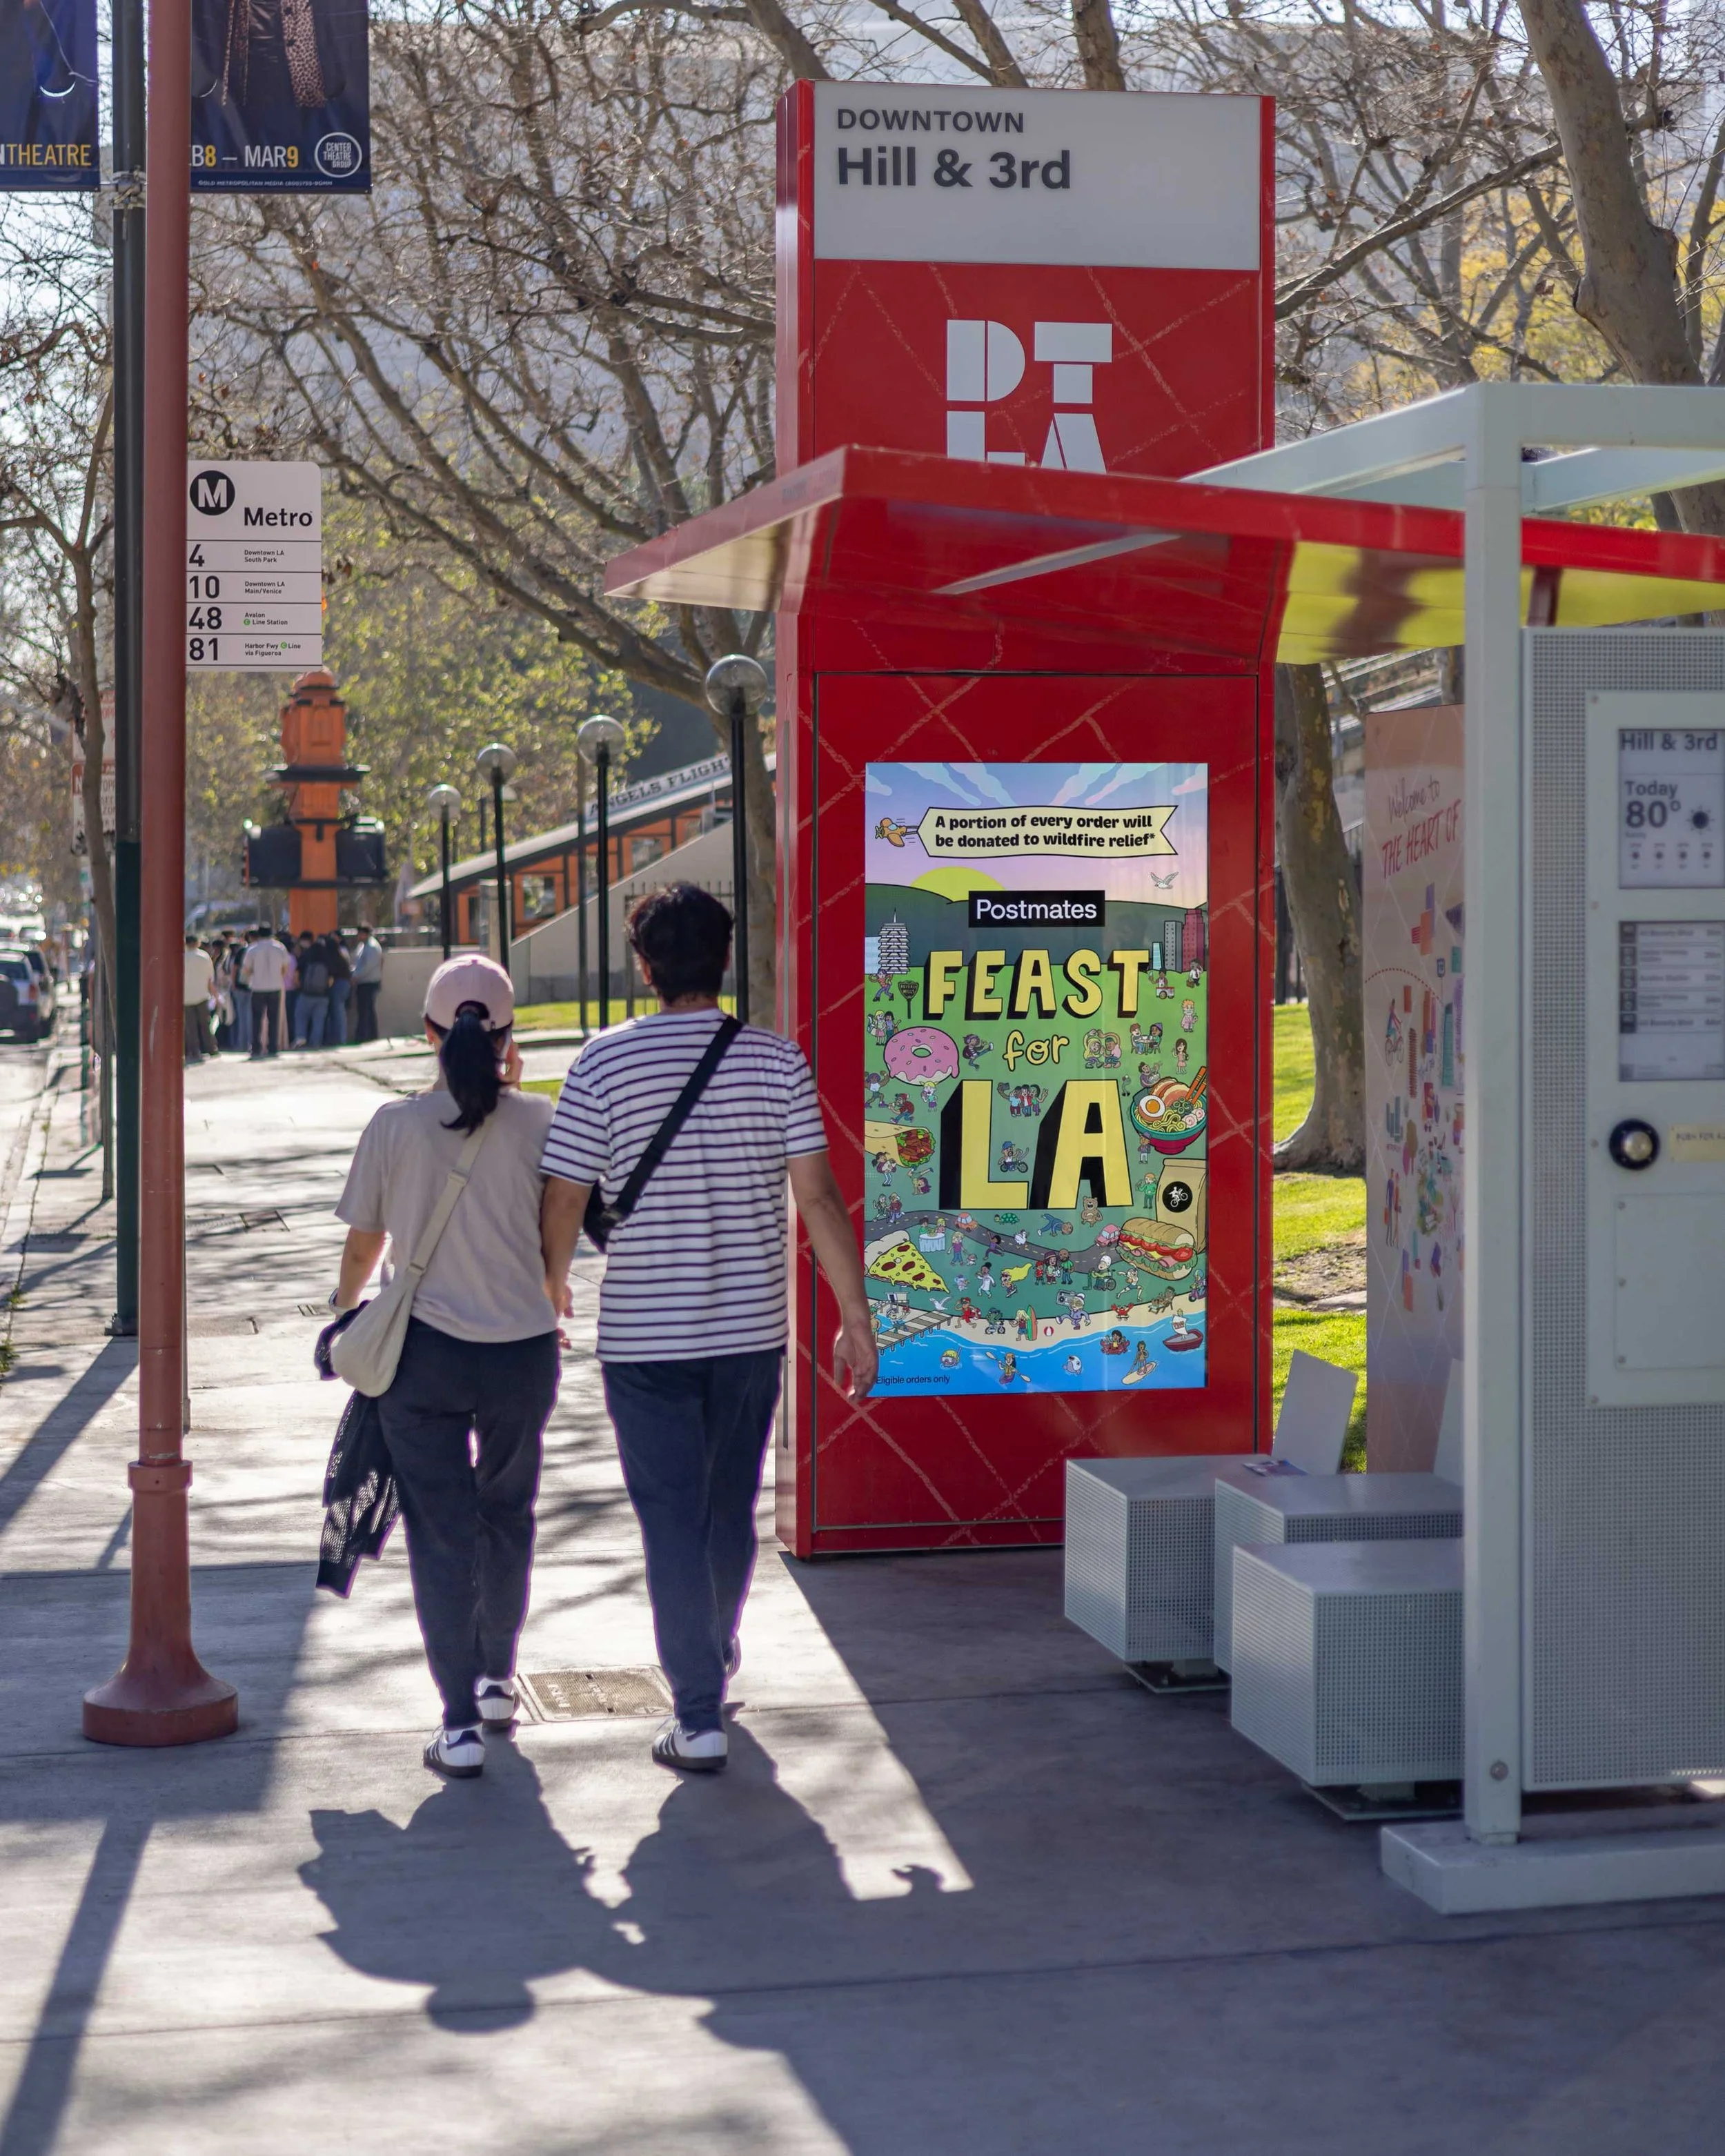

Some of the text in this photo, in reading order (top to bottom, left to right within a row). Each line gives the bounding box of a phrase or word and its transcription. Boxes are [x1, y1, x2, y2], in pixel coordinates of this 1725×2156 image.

[837, 108, 1024, 134] DOWNTOWN
[189, 144, 217, 168] B8
[244, 145, 299, 168] MAR9
[322, 150, 352, 161] THEATRE
[326, 142, 352, 151] CENTER
[332, 159, 352, 168] GROUP
[838, 146, 1071, 190] Hill & 3rd
[197, 477, 228, 508] M
[244, 506, 313, 527] Metro
[188, 544, 205, 567] 4
[188, 575, 220, 599] 10
[188, 606, 222, 631] 48
[188, 637, 219, 661] 81
[1619, 731, 1718, 751] Hill & 3rd
[669, 755, 731, 789] FLIGH
[1388, 774, 1440, 824] Welcome to
[1624, 780, 1678, 800] Today
[935, 814, 1153, 831] A portion of every order will
[1626, 800, 1682, 829] 80°
[935, 833, 955, 847] be
[958, 834, 1019, 847] donated
[1024, 833, 1040, 846] to
[1043, 833, 1105, 847] wildfire
[1382, 798, 1461, 879] THE HEART OF
[976, 898, 1097, 920] Postmates
[923, 949, 1151, 1020] FEAST
[1003, 1029, 1070, 1071] for
[939, 1080, 1134, 1210] LA
[876, 1374, 950, 1386] Eligible orders only
